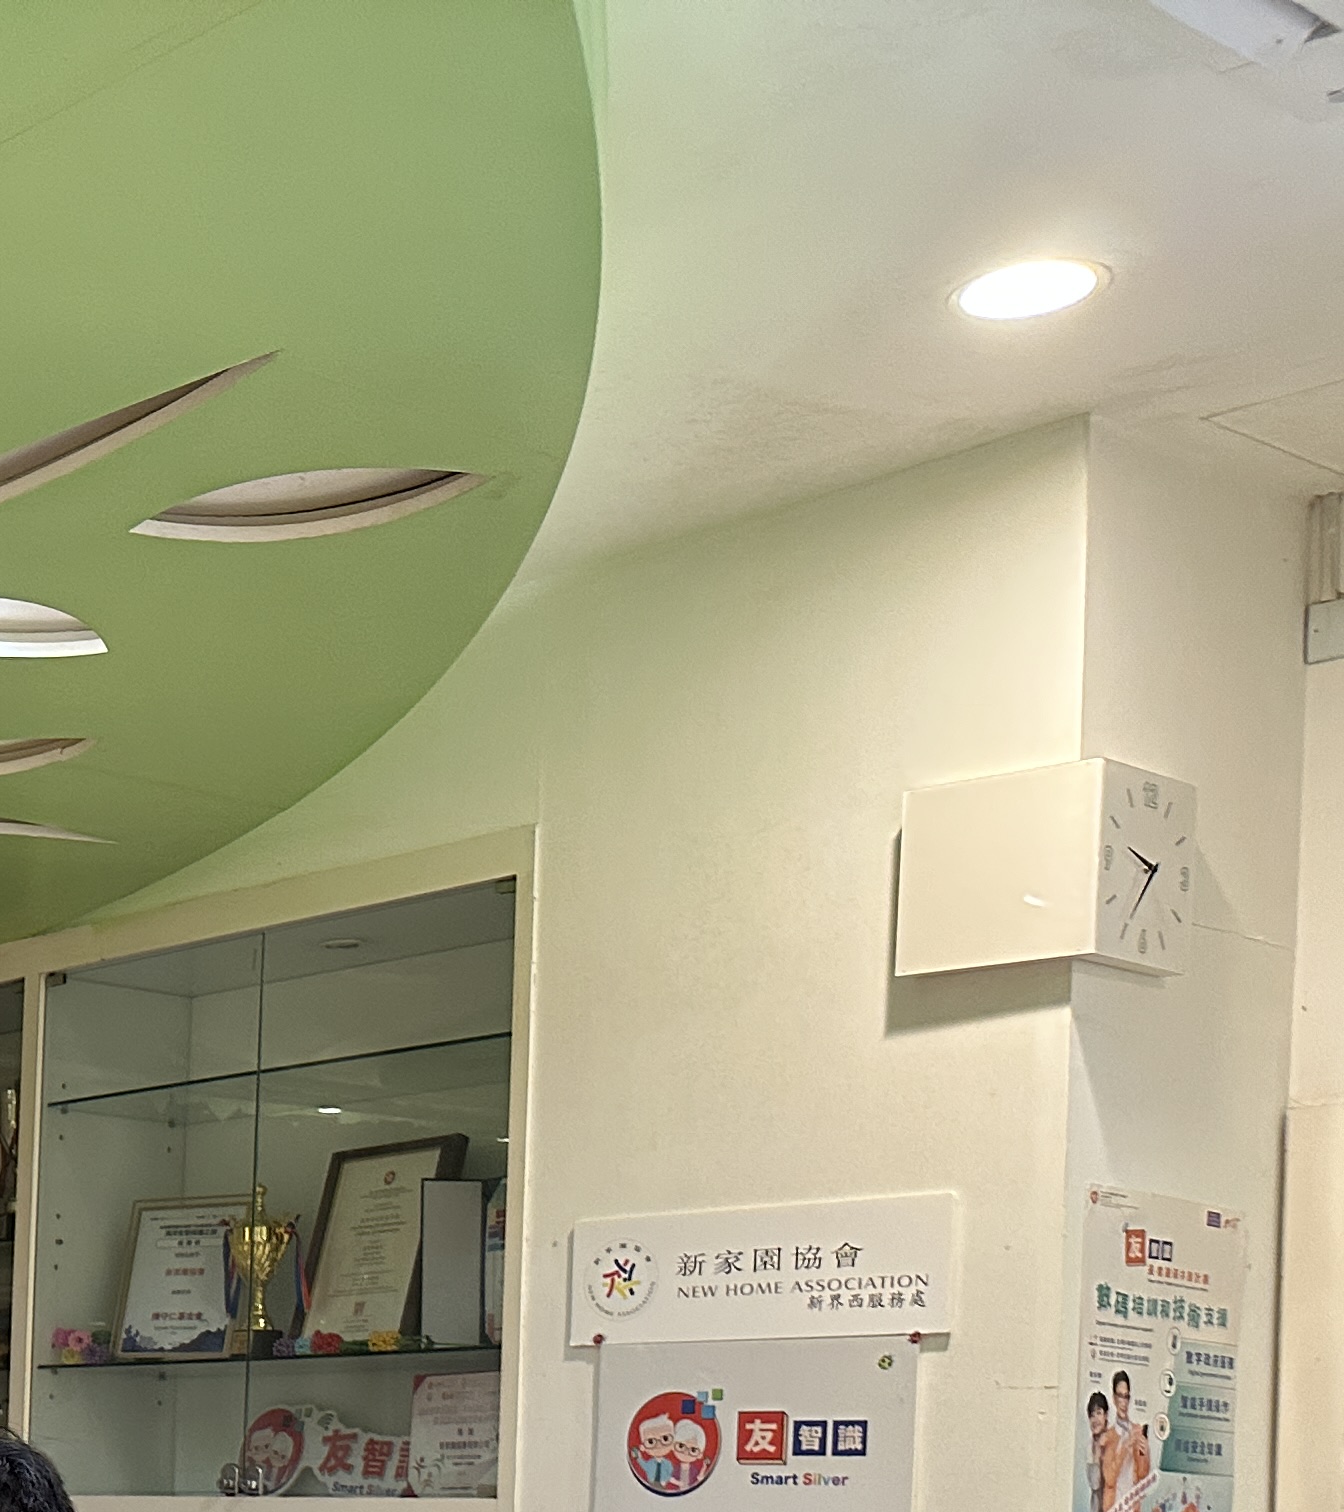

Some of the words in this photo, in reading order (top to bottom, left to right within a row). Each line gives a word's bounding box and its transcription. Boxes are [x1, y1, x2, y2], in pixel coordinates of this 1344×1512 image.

[676, 1242, 863, 1276] 新家園協會
[677, 1285, 718, 1299] NEW
[725, 1281, 783, 1297] HOME
[790, 1274, 929, 1295] ASSOCIATION
[807, 1290, 927, 1311] 新界西服務處
[744, 1418, 864, 1453] 友智識
[750, 1472, 799, 1486] Smart
[802, 1472, 850, 1486] Silver
